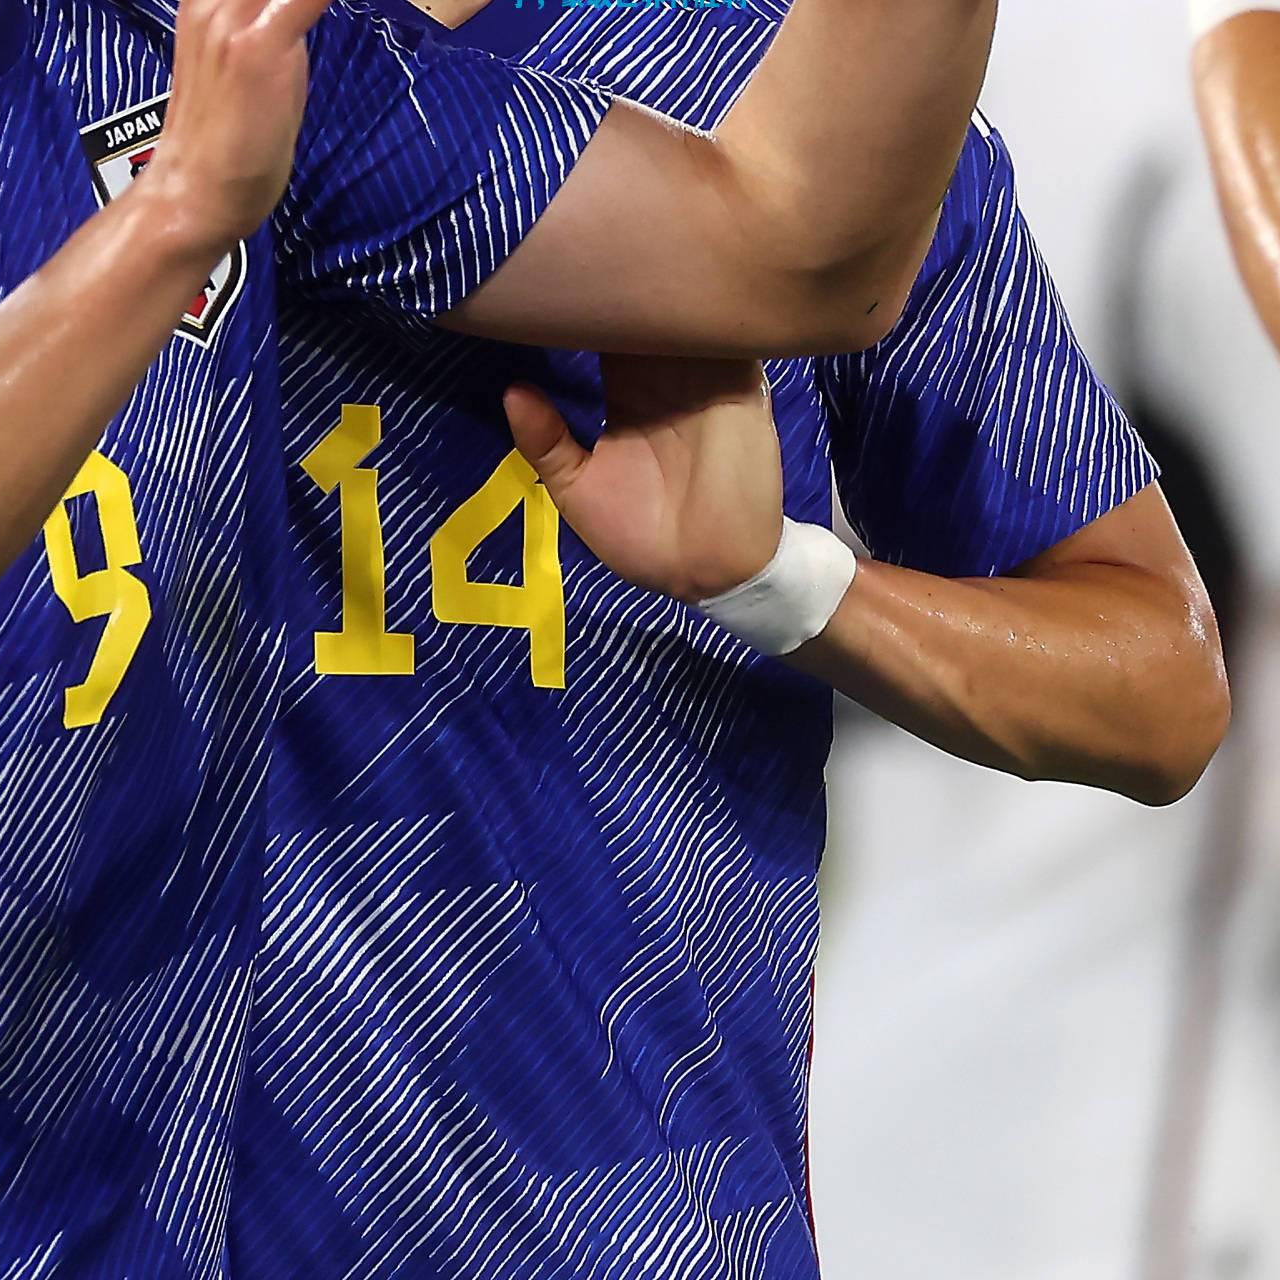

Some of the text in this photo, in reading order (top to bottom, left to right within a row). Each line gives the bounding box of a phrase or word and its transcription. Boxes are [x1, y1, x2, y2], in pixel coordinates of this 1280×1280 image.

[105, 111, 162, 149] JAPAN
[42, 449, 152, 729] 9
[299, 403, 566, 689] 14
